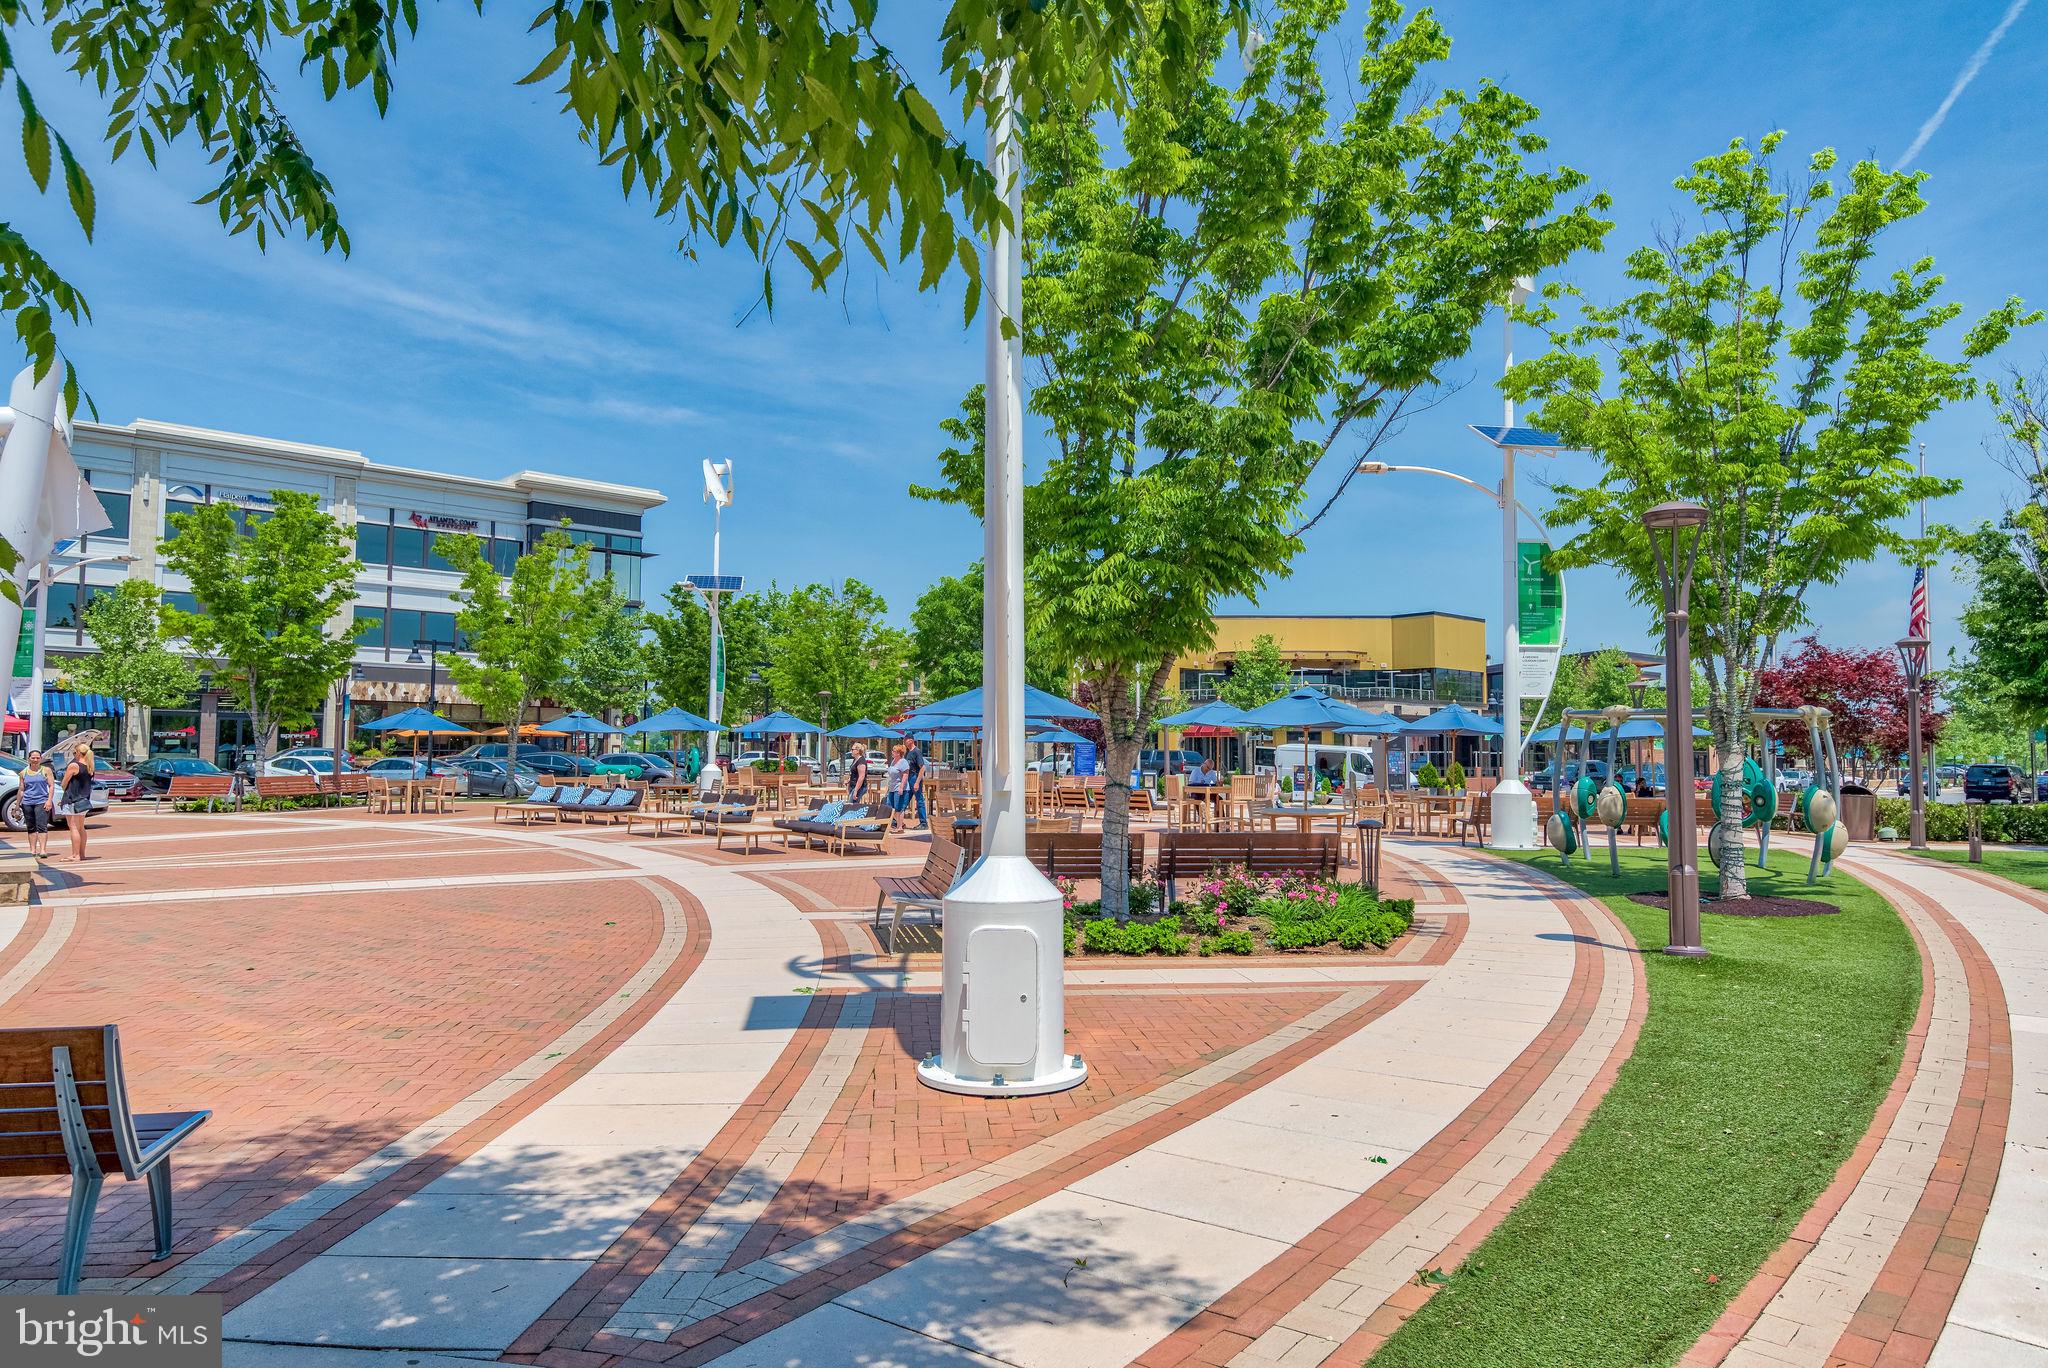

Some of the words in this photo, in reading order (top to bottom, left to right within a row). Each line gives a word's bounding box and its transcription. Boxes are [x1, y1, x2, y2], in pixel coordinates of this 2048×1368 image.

[219, 491, 248, 502] Halpern
[428, 515, 459, 524] ATLANTIC
[460, 519, 479, 528] COAST
